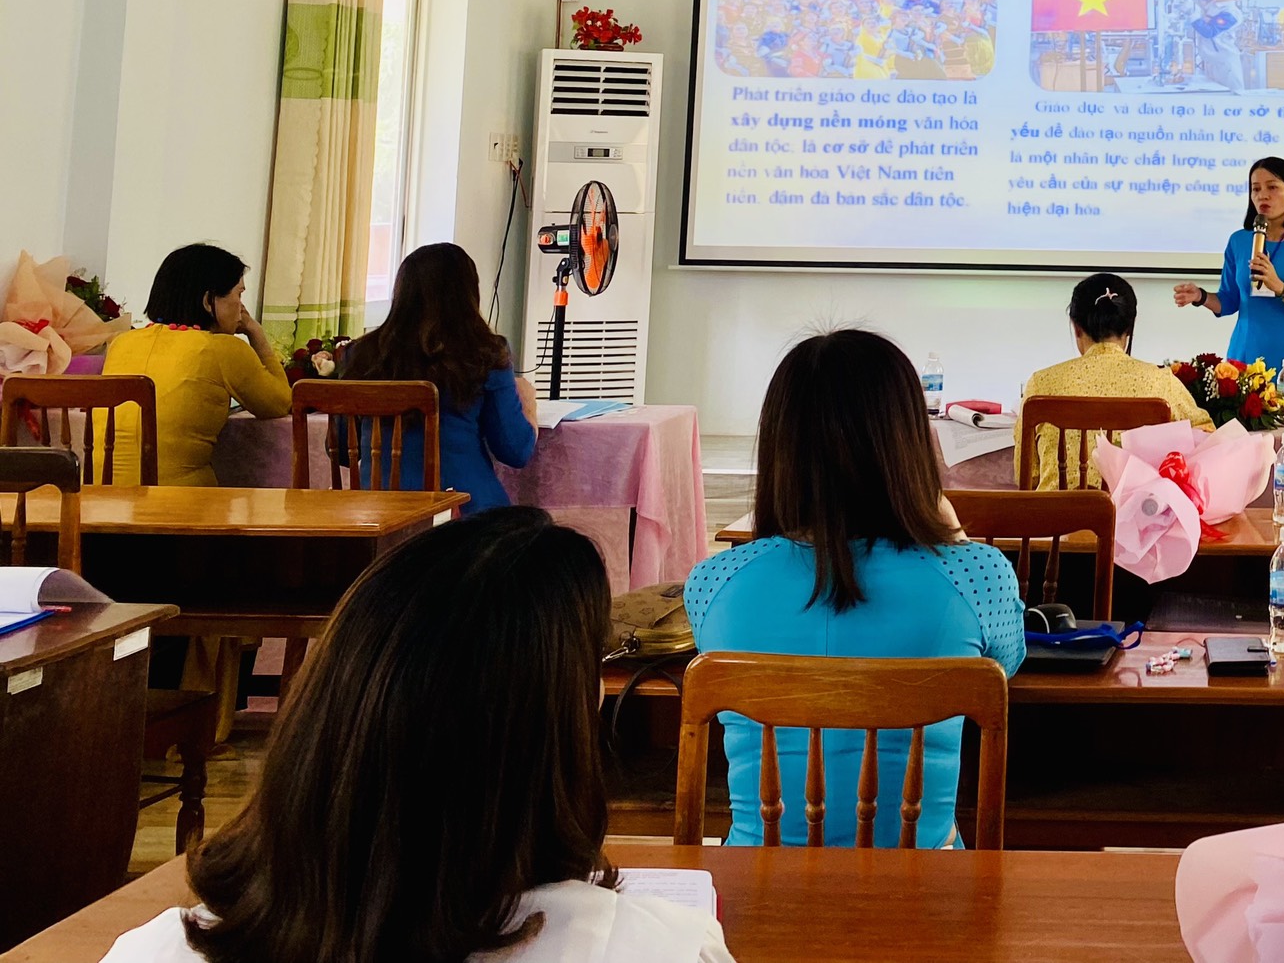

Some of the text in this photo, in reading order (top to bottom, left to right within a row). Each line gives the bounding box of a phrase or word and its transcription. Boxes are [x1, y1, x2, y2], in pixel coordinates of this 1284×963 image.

[732, 86, 769, 101] Phát
[818, 88, 856, 105] giáo
[860, 89, 891, 105] dục
[932, 92, 957, 106] tạo
[963, 90, 978, 105] là
[1035, 101, 1070, 113] Giáo
[1077, 101, 1104, 116] dục
[1114, 103, 1129, 114] và
[1172, 105, 1195, 117] tạo
[1203, 104, 1215, 116] là
[1224, 108, 1243, 116] cơ
[1249, 104, 1270, 117] sở
[731, 109, 979, 132] xây dựng nền móng văn hóa
[1010, 121, 1040, 141] yếu
[1100, 129, 1123, 142] tạo
[1128, 125, 1174, 143] nguồn
[1180, 129, 1214, 142] nhân
[728, 138, 758, 152] dân
[802, 139, 817, 153] là
[823, 142, 845, 154] cơ
[848, 139, 870, 154] sở
[898, 140, 935, 158] phát
[1010, 150, 1022, 163] là
[1029, 150, 1057, 165] một
[1064, 152, 1098, 165] nhân
[1105, 152, 1128, 167] lực
[1134, 150, 1166, 165] chất
[1172, 154, 1216, 170] lượng
[1222, 158, 1246, 167] cao
[837, 165, 871, 181] Việt
[878, 165, 918, 180] Nam
[1008, 176, 1034, 192] yêu
[1040, 173, 1067, 189] cầu
[1072, 176, 1098, 190] của
[1104, 179, 1124, 192] sự
[1129, 178, 1180, 195] nghiệp
[1185, 180, 1219, 195] công
[871, 188, 899, 206] sắc
[904, 191, 934, 206] dân
[1007, 201, 1040, 216] hiện
